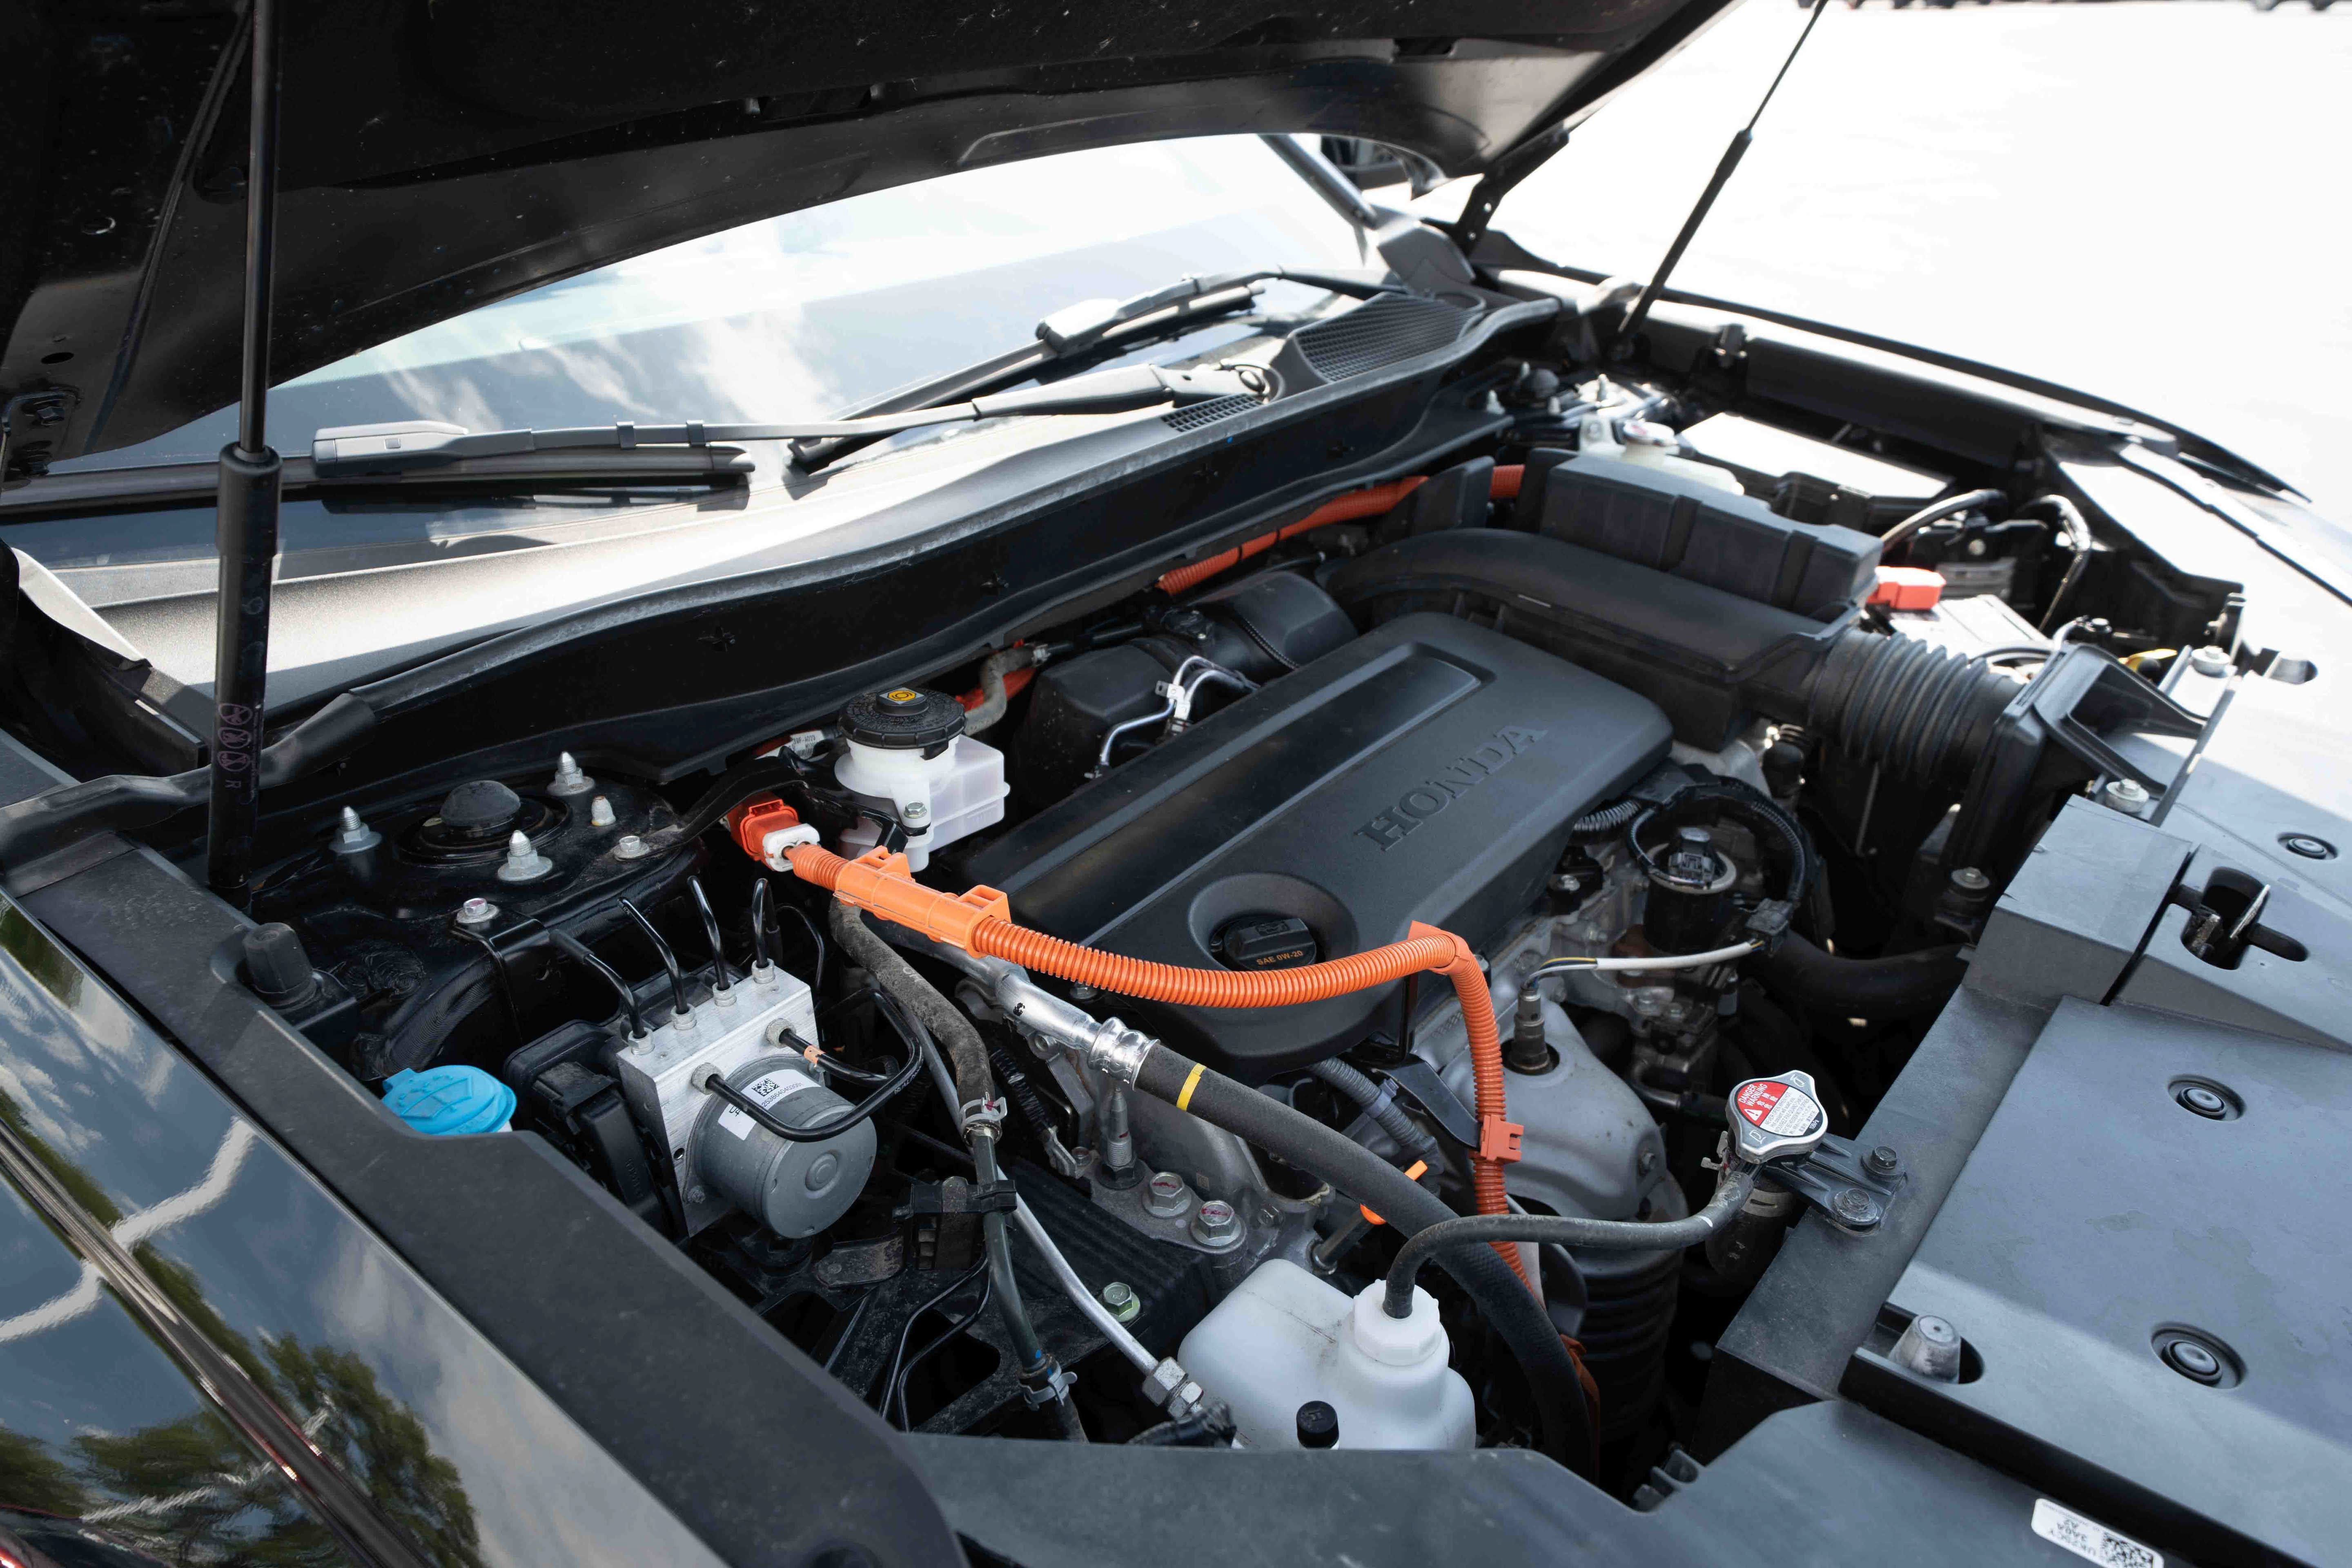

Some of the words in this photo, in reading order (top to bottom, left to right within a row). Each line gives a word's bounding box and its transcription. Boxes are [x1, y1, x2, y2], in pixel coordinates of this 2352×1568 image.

[1354, 725, 1548, 851] HONDA
[1256, 956, 1276, 965] SAE
[1277, 950, 1304, 961] 0W-20
[1738, 1084, 1757, 1103] DANGER
[1745, 1083, 1768, 1107] WARNUNG
